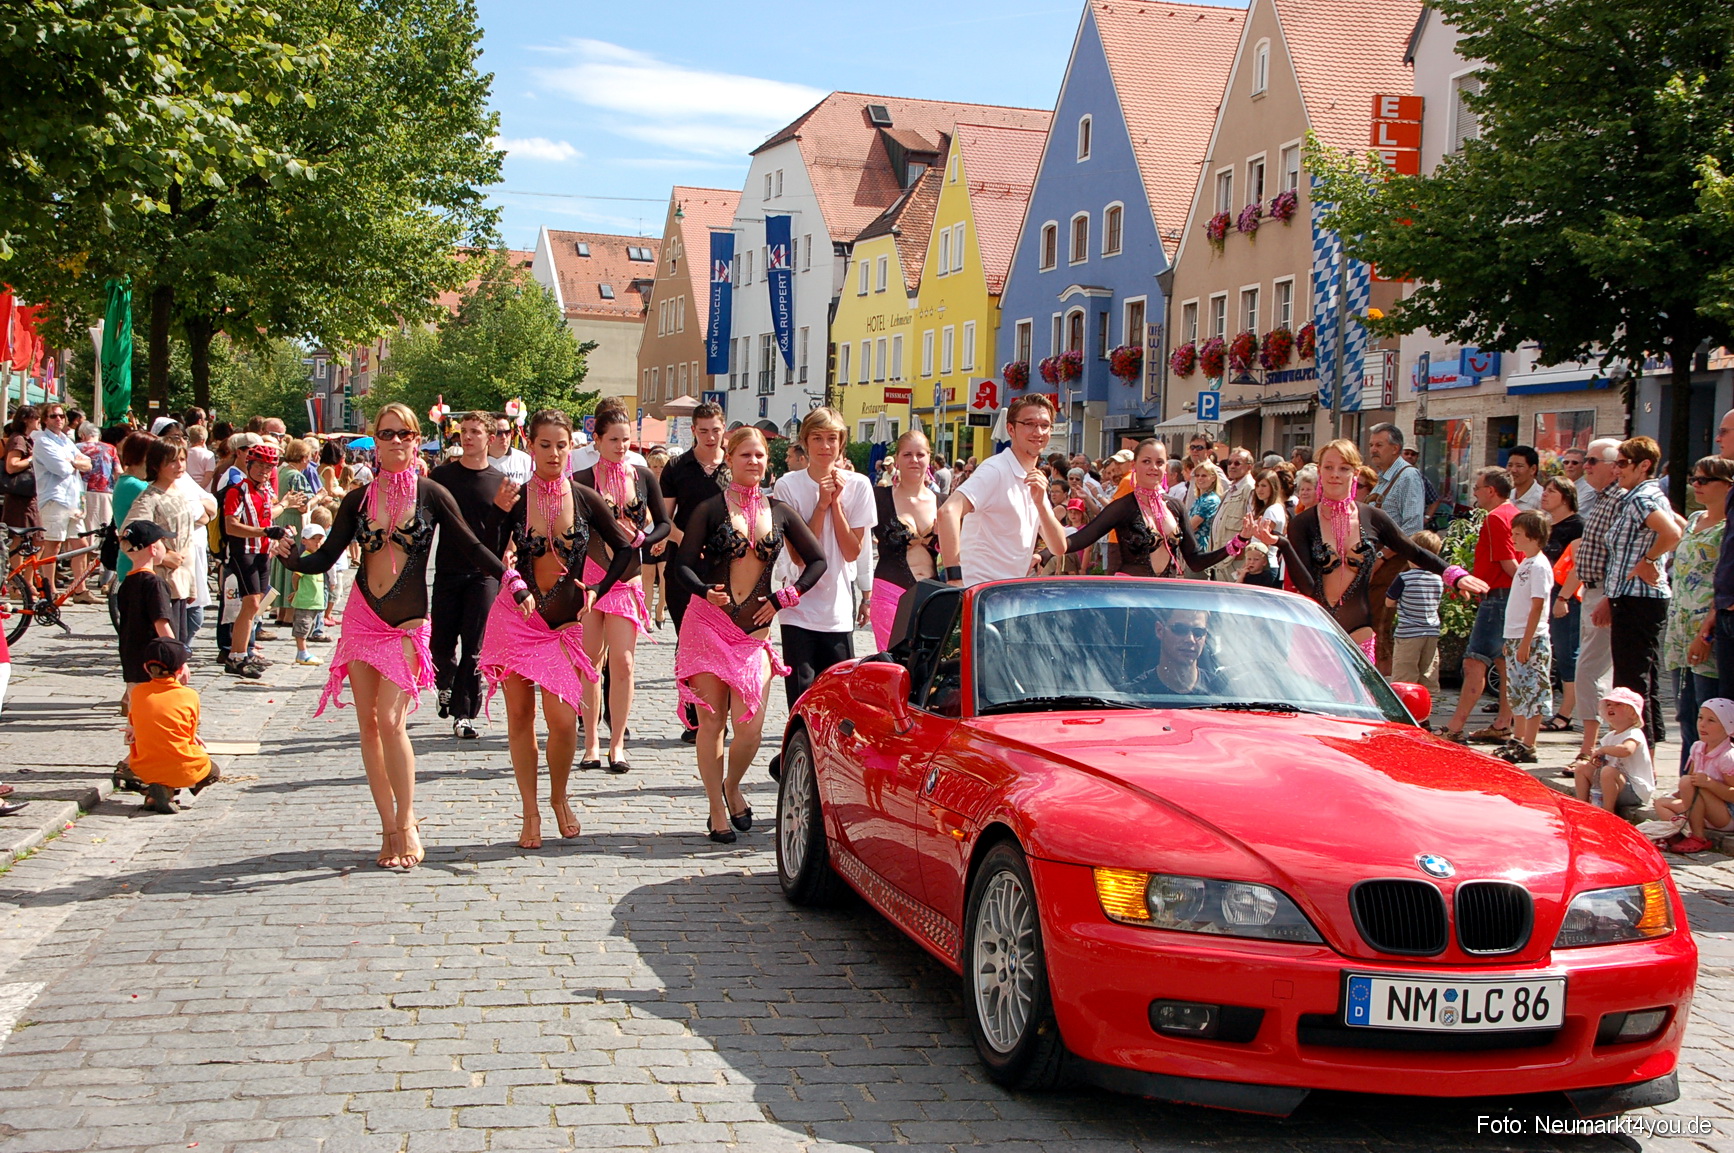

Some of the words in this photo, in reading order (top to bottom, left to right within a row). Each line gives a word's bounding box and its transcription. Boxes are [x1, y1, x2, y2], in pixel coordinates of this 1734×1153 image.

[778, 273, 788, 329] RUPPERT
[866, 314, 886, 333] HOTEL
[781, 330, 789, 352] K&L
[1148, 338, 1160, 396] WITTL
[1385, 353, 1394, 406] KINO
[1202, 394, 1215, 417] P
[1354, 1006, 1364, 1018] D
[1386, 985, 1438, 1023] NM
[1460, 988, 1504, 1024] LC
[1512, 986, 1550, 1023] 86
